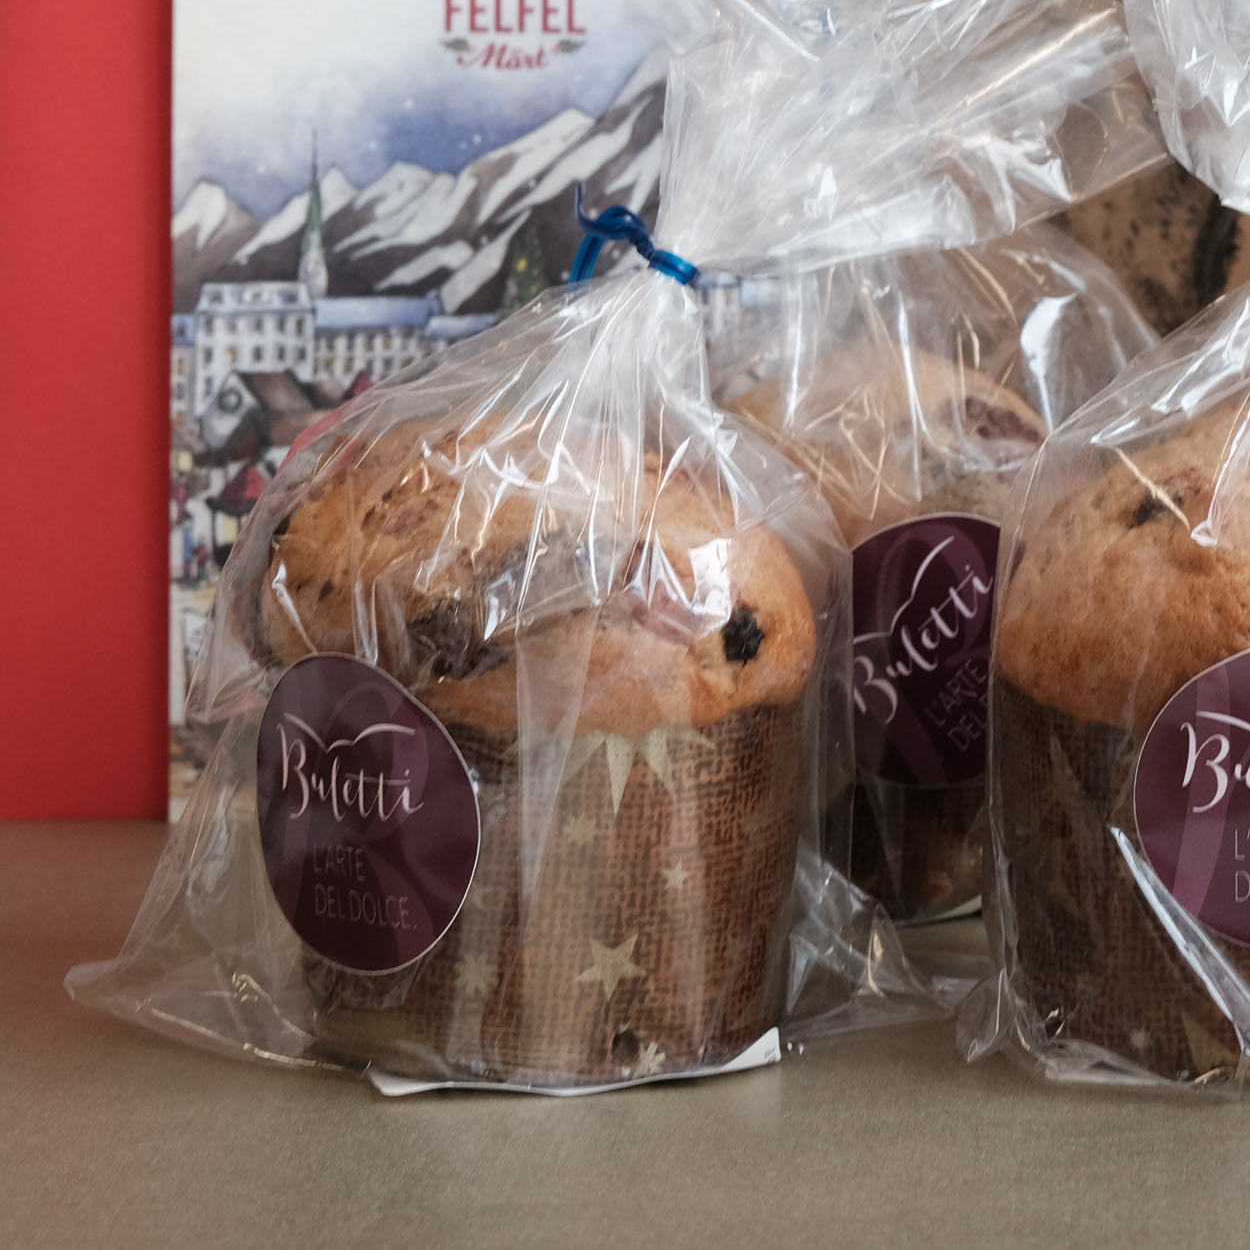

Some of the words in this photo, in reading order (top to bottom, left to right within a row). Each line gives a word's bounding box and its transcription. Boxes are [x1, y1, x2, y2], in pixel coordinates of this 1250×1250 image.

[853, 564, 994, 725] Buletti
[924, 659, 988, 727] L'ARTE
[276, 722, 424, 823] Buletti
[313, 841, 365, 882] L'ARTE
[314, 883, 347, 920] DEL
